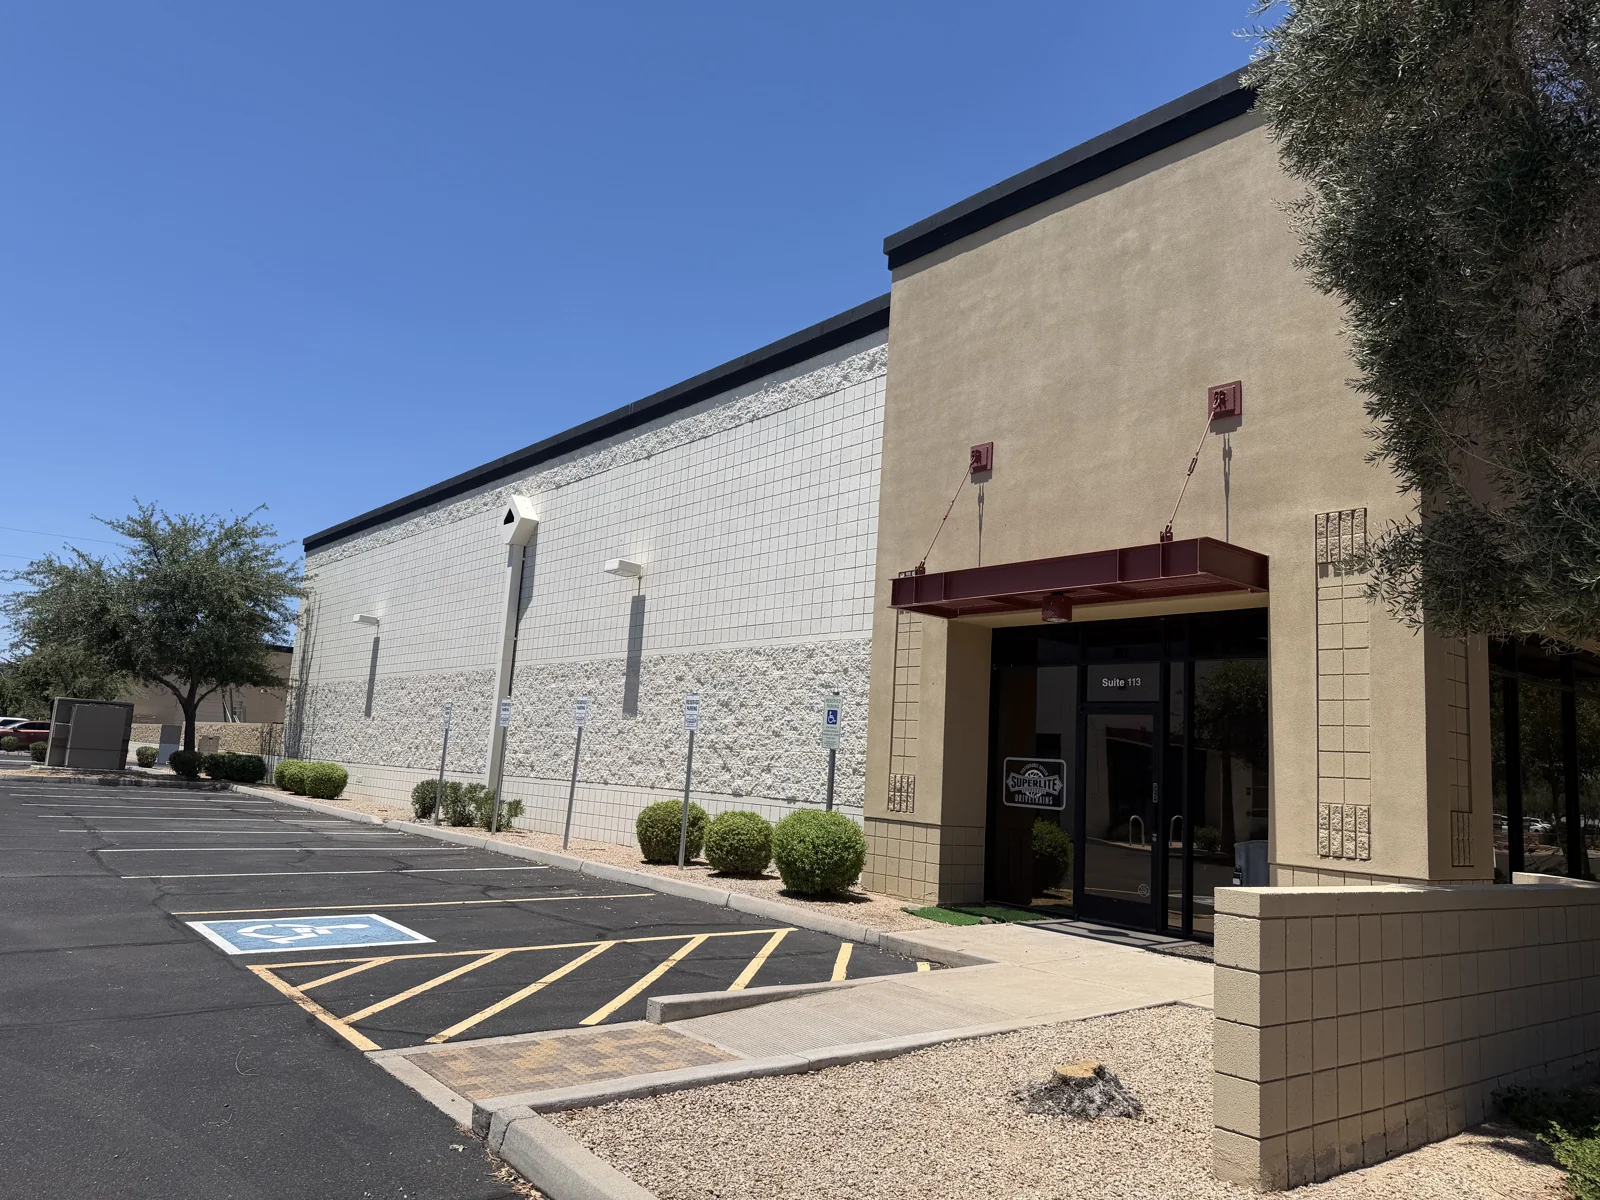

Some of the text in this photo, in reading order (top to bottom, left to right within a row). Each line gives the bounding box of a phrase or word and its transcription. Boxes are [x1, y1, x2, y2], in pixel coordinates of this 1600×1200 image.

[1102, 677, 1141, 687] Suite 113
[1011, 775, 1058, 792] SUPERLITE
[1015, 794, 1053, 805] DRIVETRAINS
